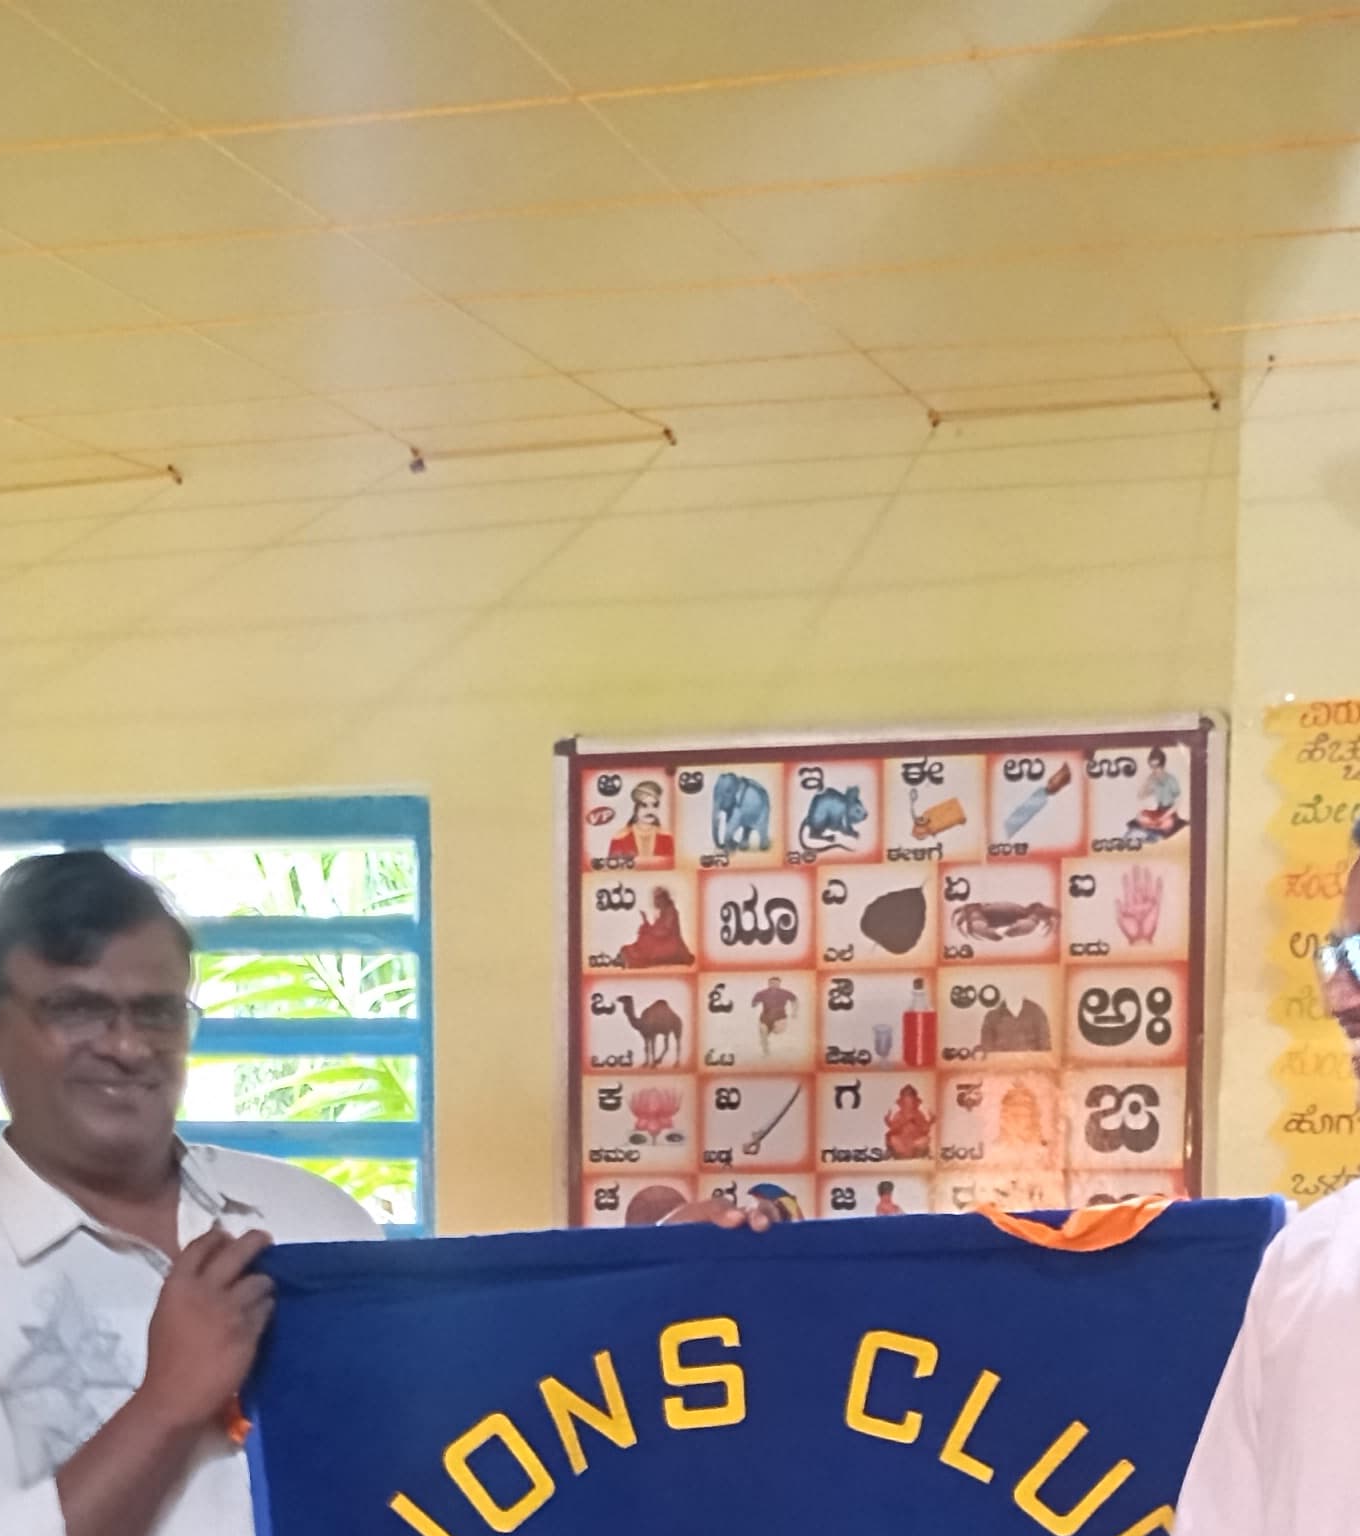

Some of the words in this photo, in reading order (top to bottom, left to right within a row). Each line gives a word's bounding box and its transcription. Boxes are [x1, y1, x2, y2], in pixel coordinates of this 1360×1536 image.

[798, 767, 825, 792] ಇ
[901, 755, 945, 786] ಈ
[1003, 757, 1046, 782] ಉ
[1086, 755, 1138, 779] ಊ
[597, 774, 623, 796] ಅ
[678, 771, 705, 794] ಆ
[595, 880, 637, 912] ಋ
[821, 879, 849, 906] ಎ
[943, 875, 971, 902] ಏ
[1068, 873, 1097, 899] ಐ
[590, 991, 617, 1016] ಒ
[707, 983, 735, 1014] ಓ
[827, 977, 855, 1012] ಔ
[949, 983, 1001, 1010] ಅಂ
[1077, 986, 1173, 1047] ಅಃ
[597, 1081, 624, 1112] ಕ
[714, 1086, 742, 1111] ಖ
[833, 1078, 862, 1110] ಗ
[594, 1182, 621, 1212] ಚ
[830, 1187, 857, 1212] ಜ
